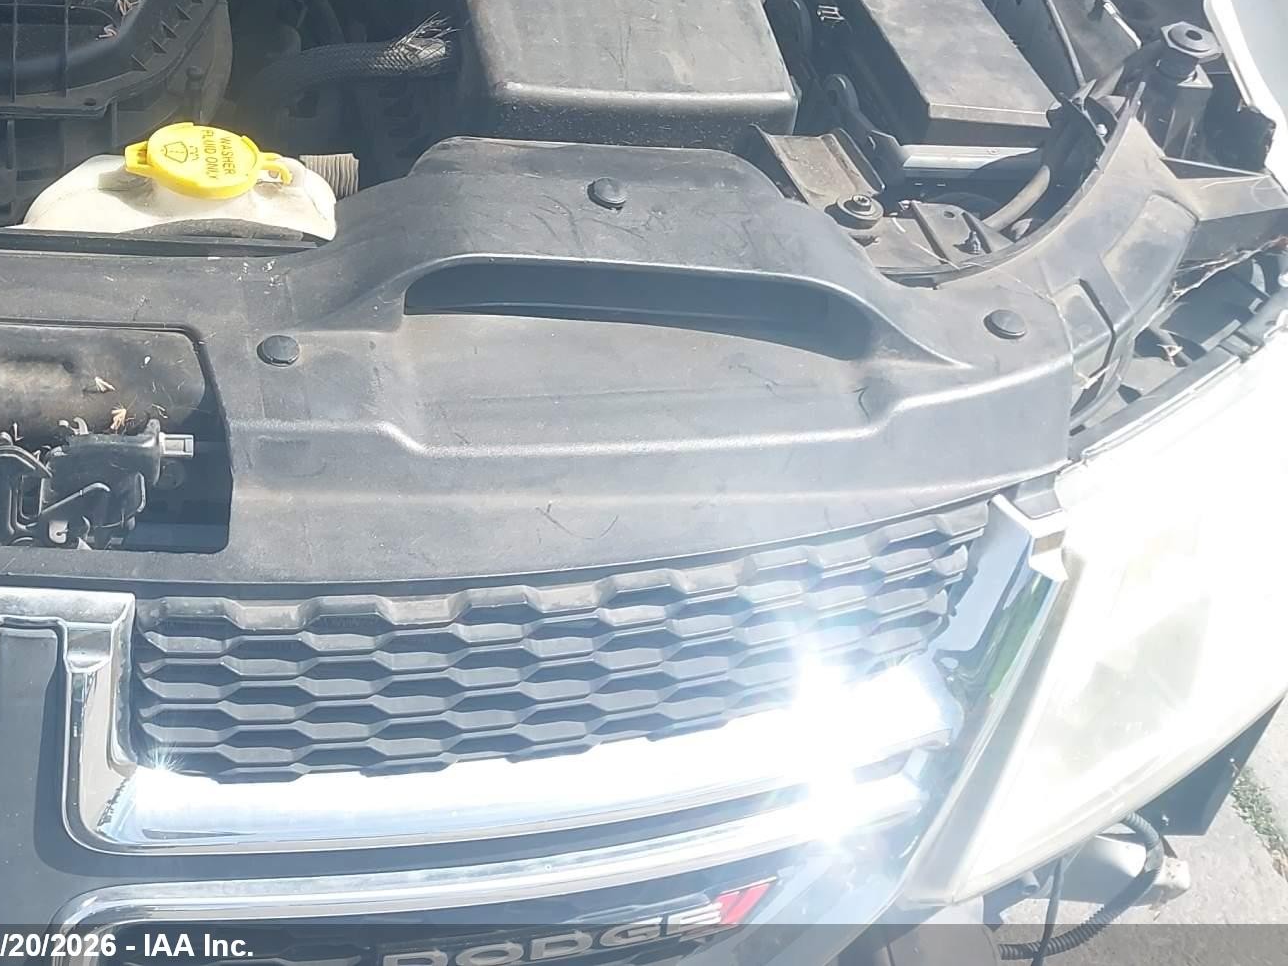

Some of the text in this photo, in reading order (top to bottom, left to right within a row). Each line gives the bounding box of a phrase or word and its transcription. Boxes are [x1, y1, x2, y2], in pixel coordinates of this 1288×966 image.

[202, 130, 219, 180] FLUID ONLY
[220, 137, 236, 175] WASHER
[383, 901, 722, 966] DODGE
